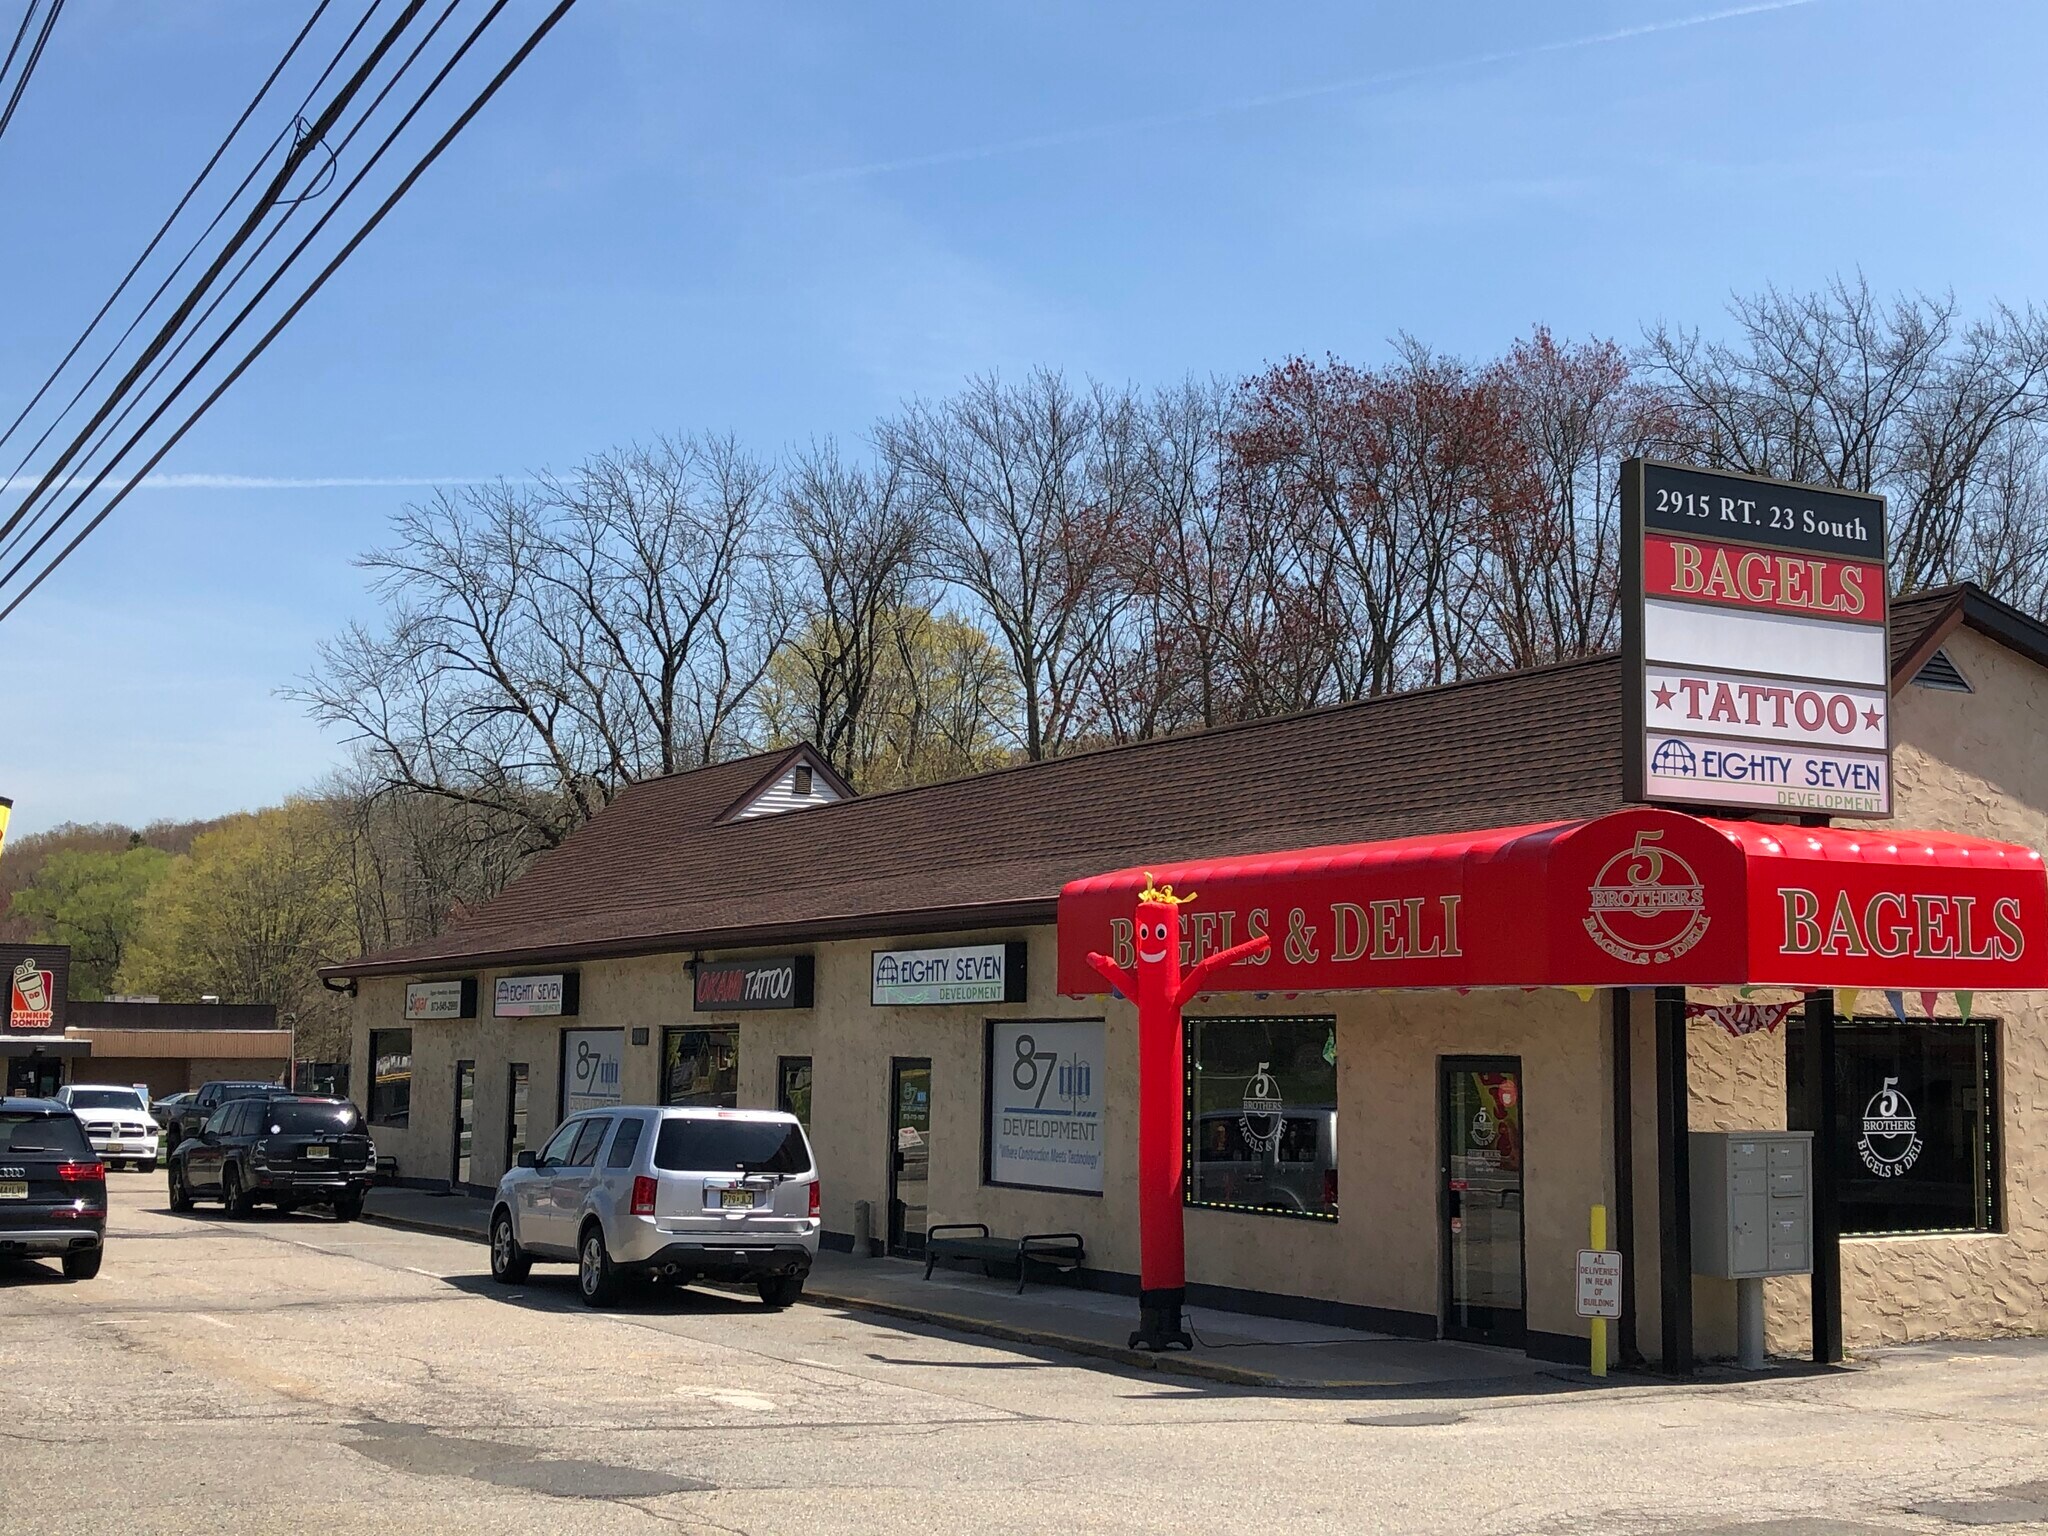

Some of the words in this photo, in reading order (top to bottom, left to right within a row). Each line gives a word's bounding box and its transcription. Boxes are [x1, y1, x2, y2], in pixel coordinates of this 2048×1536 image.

[1656, 489, 1710, 518] 2915
[1720, 497, 1761, 526] RT.
[1769, 506, 1795, 530] 23
[1802, 510, 1868, 541] South
[1670, 542, 1865, 615] BAGELS
[1679, 679, 1857, 735] TATTOO
[1701, 750, 1792, 784] EIGHTY
[1805, 759, 1880, 792] SEVEN
[1777, 791, 1882, 812] DEVELOPMENT
[1627, 829, 1664, 886] 5
[1590, 889, 1704, 907] BROTHERS
[1283, 907, 1319, 965] &
[1331, 894, 1462, 962] DELI
[1582, 915, 1650, 965] BAGELS
[1654, 951, 1671, 964] &
[1670, 913, 1712, 959] DELI
[1777, 887, 2025, 962] BAGELS
[745, 967, 792, 1000] TATTOO
[901, 959, 949, 983] EIGHTY
[956, 956, 1001, 981] SEVEN
[509, 984, 535, 1001] EIGHTY
[536, 982, 560, 1000] SEVEN
[939, 986, 1002, 1000] DEVELOPMENT
[577, 1041, 601, 1094] 87
[1013, 1034, 1057, 1109] 87
[1255, 1062, 1269, 1097] 5
[1243, 1100, 1282, 1111] BROTHERS
[1880, 1077, 1898, 1117] 5
[1003, 1118, 1097, 1141] DEVELOPMENT
[1239, 1117, 1264, 1153] BAGELS
[1266, 1140, 1273, 1151] &
[1863, 1121, 1915, 1131] BROTHERS
[1857, 1138, 1892, 1178] BAGELS
[1894, 1163, 1904, 1176] &
[1903, 1137, 1923, 1170] DELI
[1580, 1266, 1619, 1276] DELIVERIES
[1593, 1257, 1605, 1265] ALL
[1585, 1277, 1592, 1285] IN
[1595, 1278, 1612, 1286] REAR
[1594, 1288, 1604, 1296] OF
[1583, 1298, 1614, 1308] BUILDING
